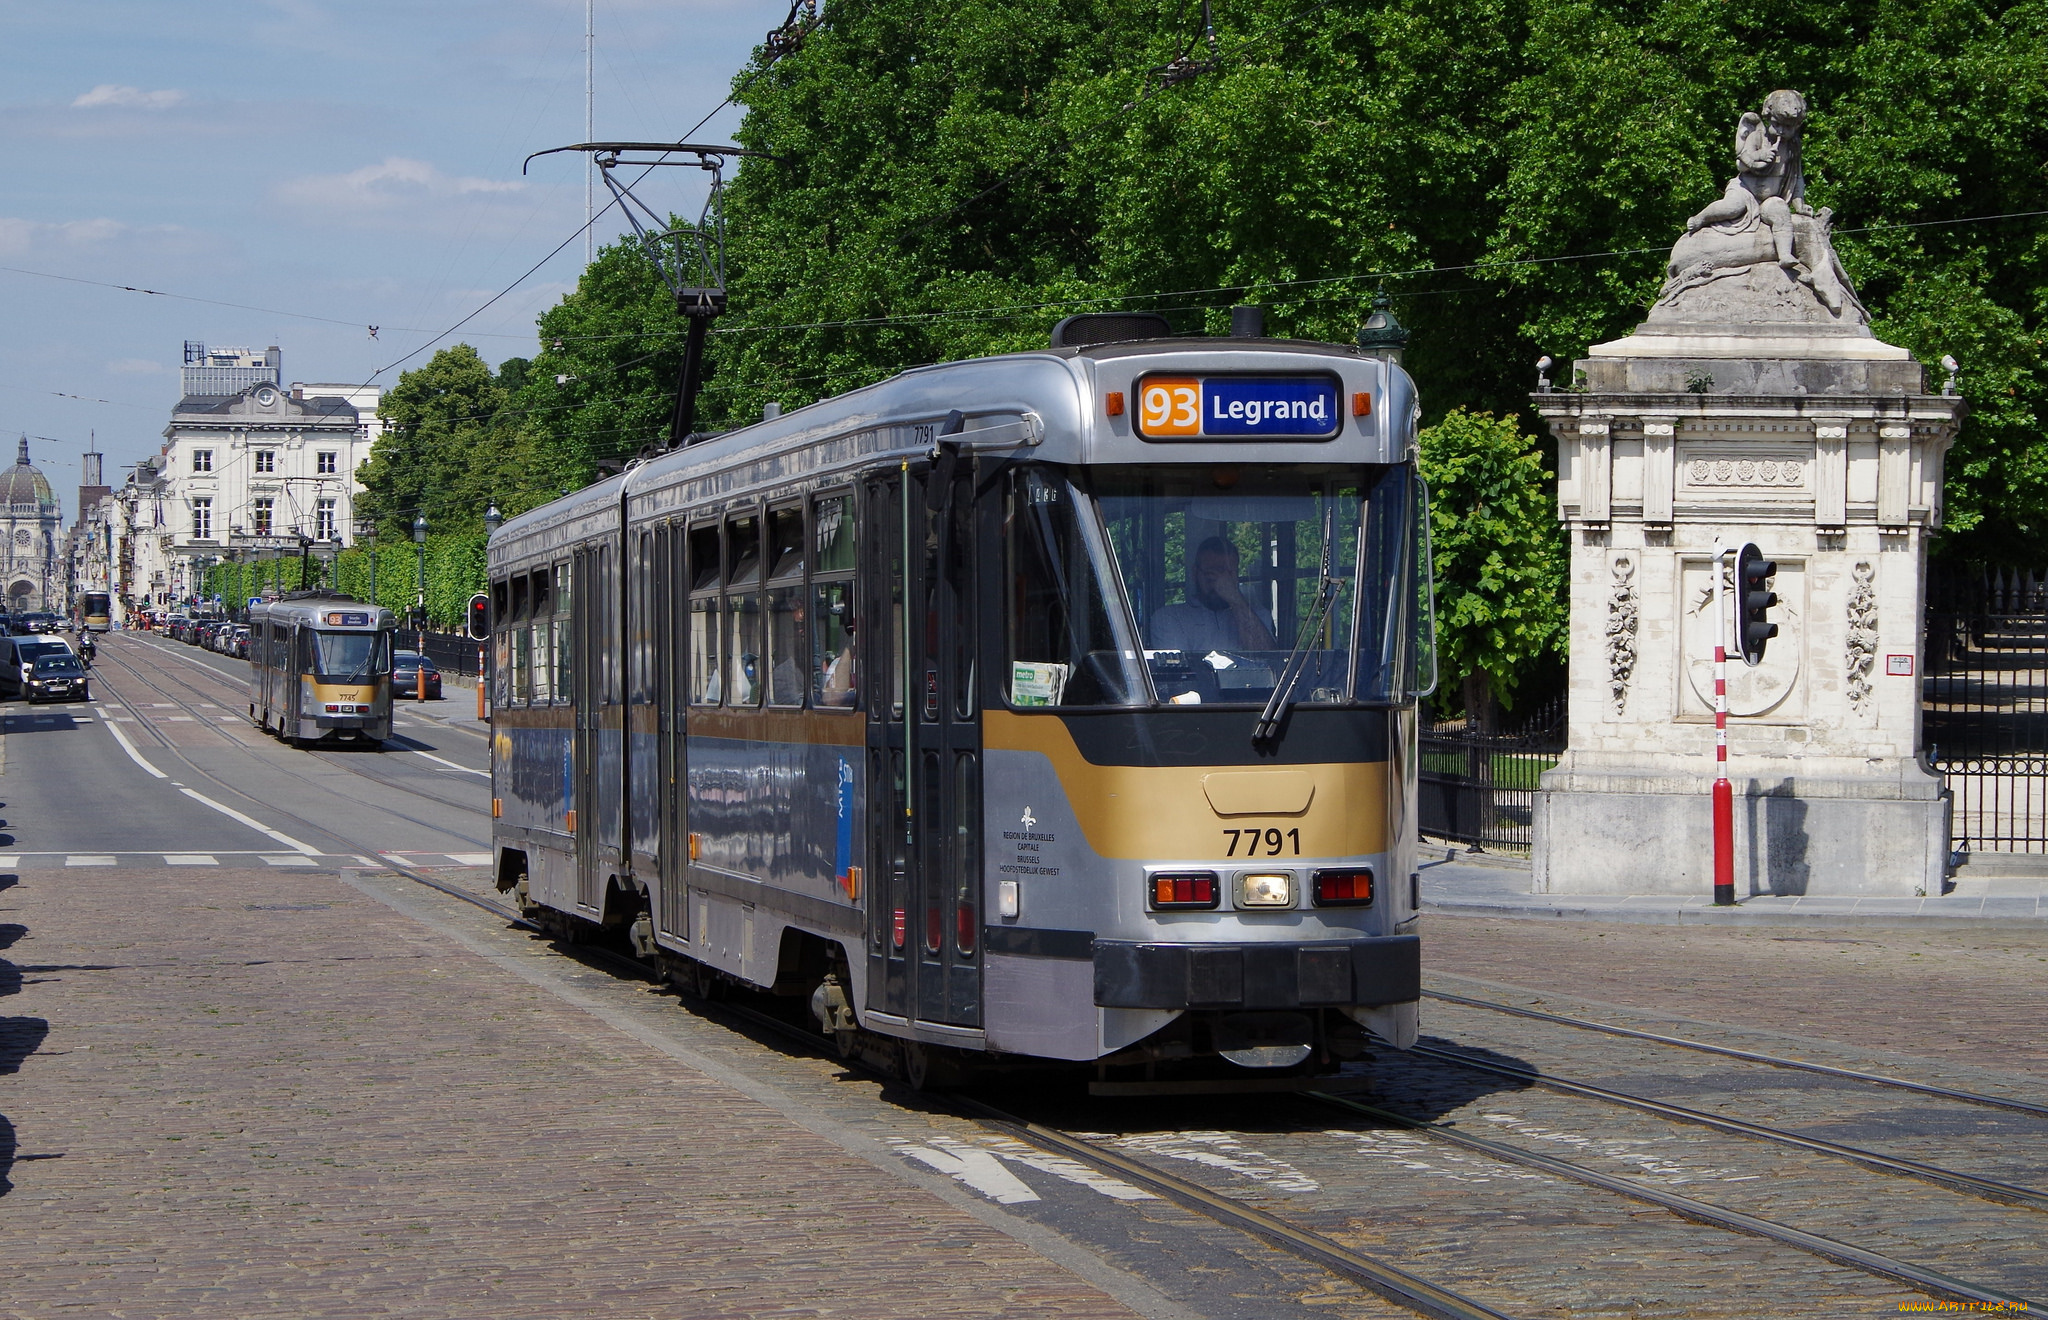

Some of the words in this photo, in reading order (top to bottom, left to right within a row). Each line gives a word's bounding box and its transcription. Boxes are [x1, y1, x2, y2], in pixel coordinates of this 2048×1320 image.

[1144, 387, 1198, 427] 93
[1213, 394, 1325, 426] Legrand
[914, 425, 934, 445] 7791
[329, 615, 341, 625] 93
[1016, 670, 1034, 679] metro
[1021, 832, 1028, 841] DE
[1029, 833, 1055, 842] BRUXELLES
[1017, 842, 1040, 851] CAPITALE
[1223, 828, 1300, 857] 7791
[1017, 855, 1040, 864] BRUSSELS
[1039, 867, 1060, 876] GEWEST
